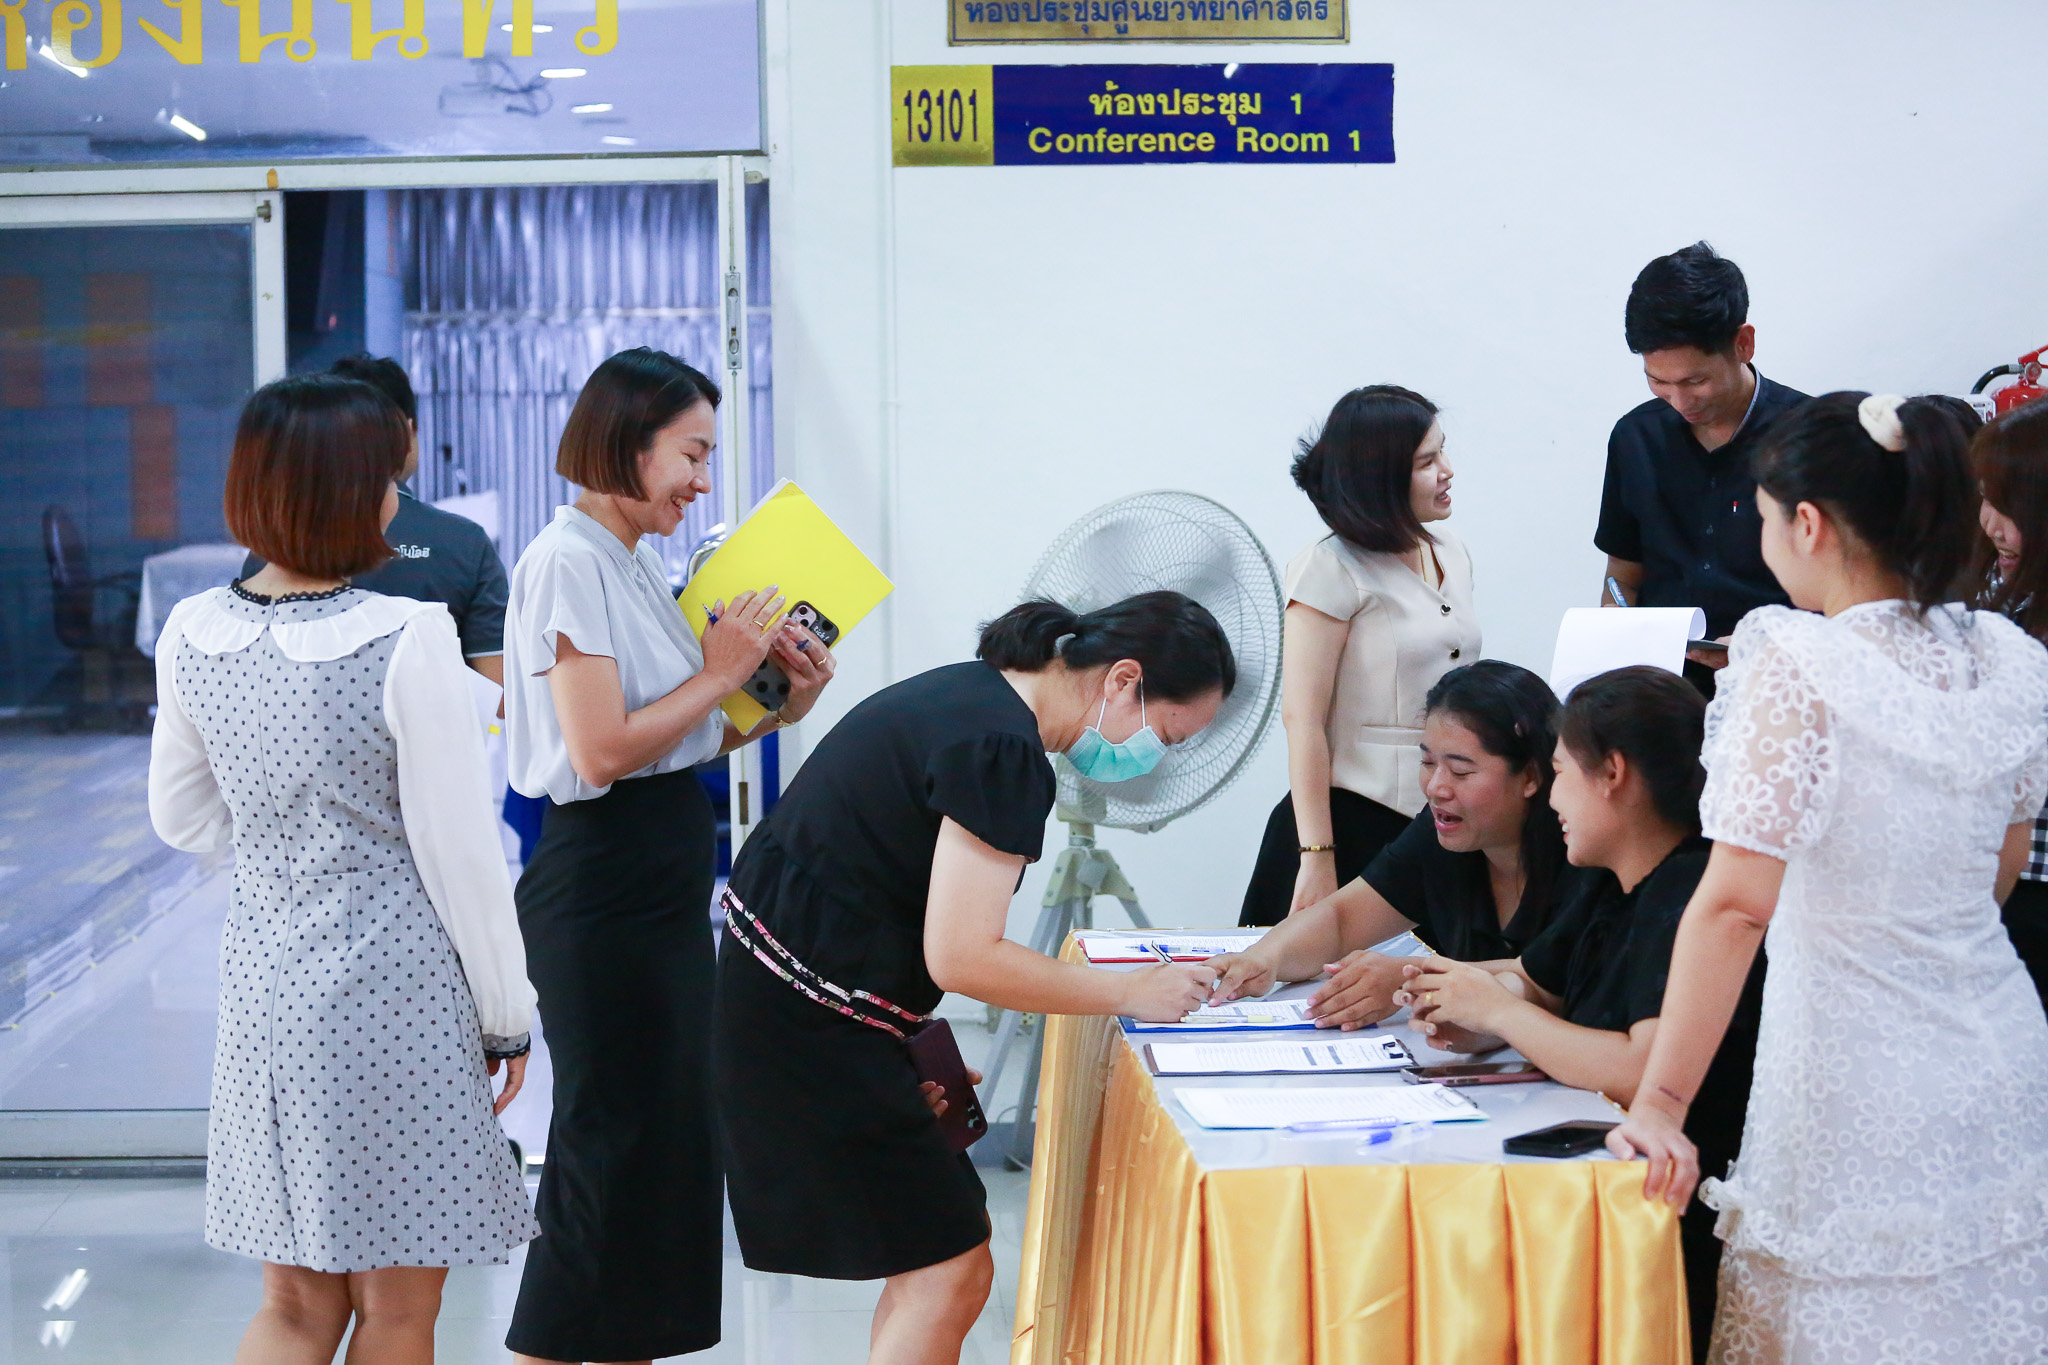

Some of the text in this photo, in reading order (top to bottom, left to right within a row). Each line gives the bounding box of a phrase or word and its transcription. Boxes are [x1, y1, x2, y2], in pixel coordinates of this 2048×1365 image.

[903, 89, 978, 143] 13101
[1089, 80, 1302, 125] ห้องประชุม 1
[1028, 127, 1360, 153] Conference Room 1
